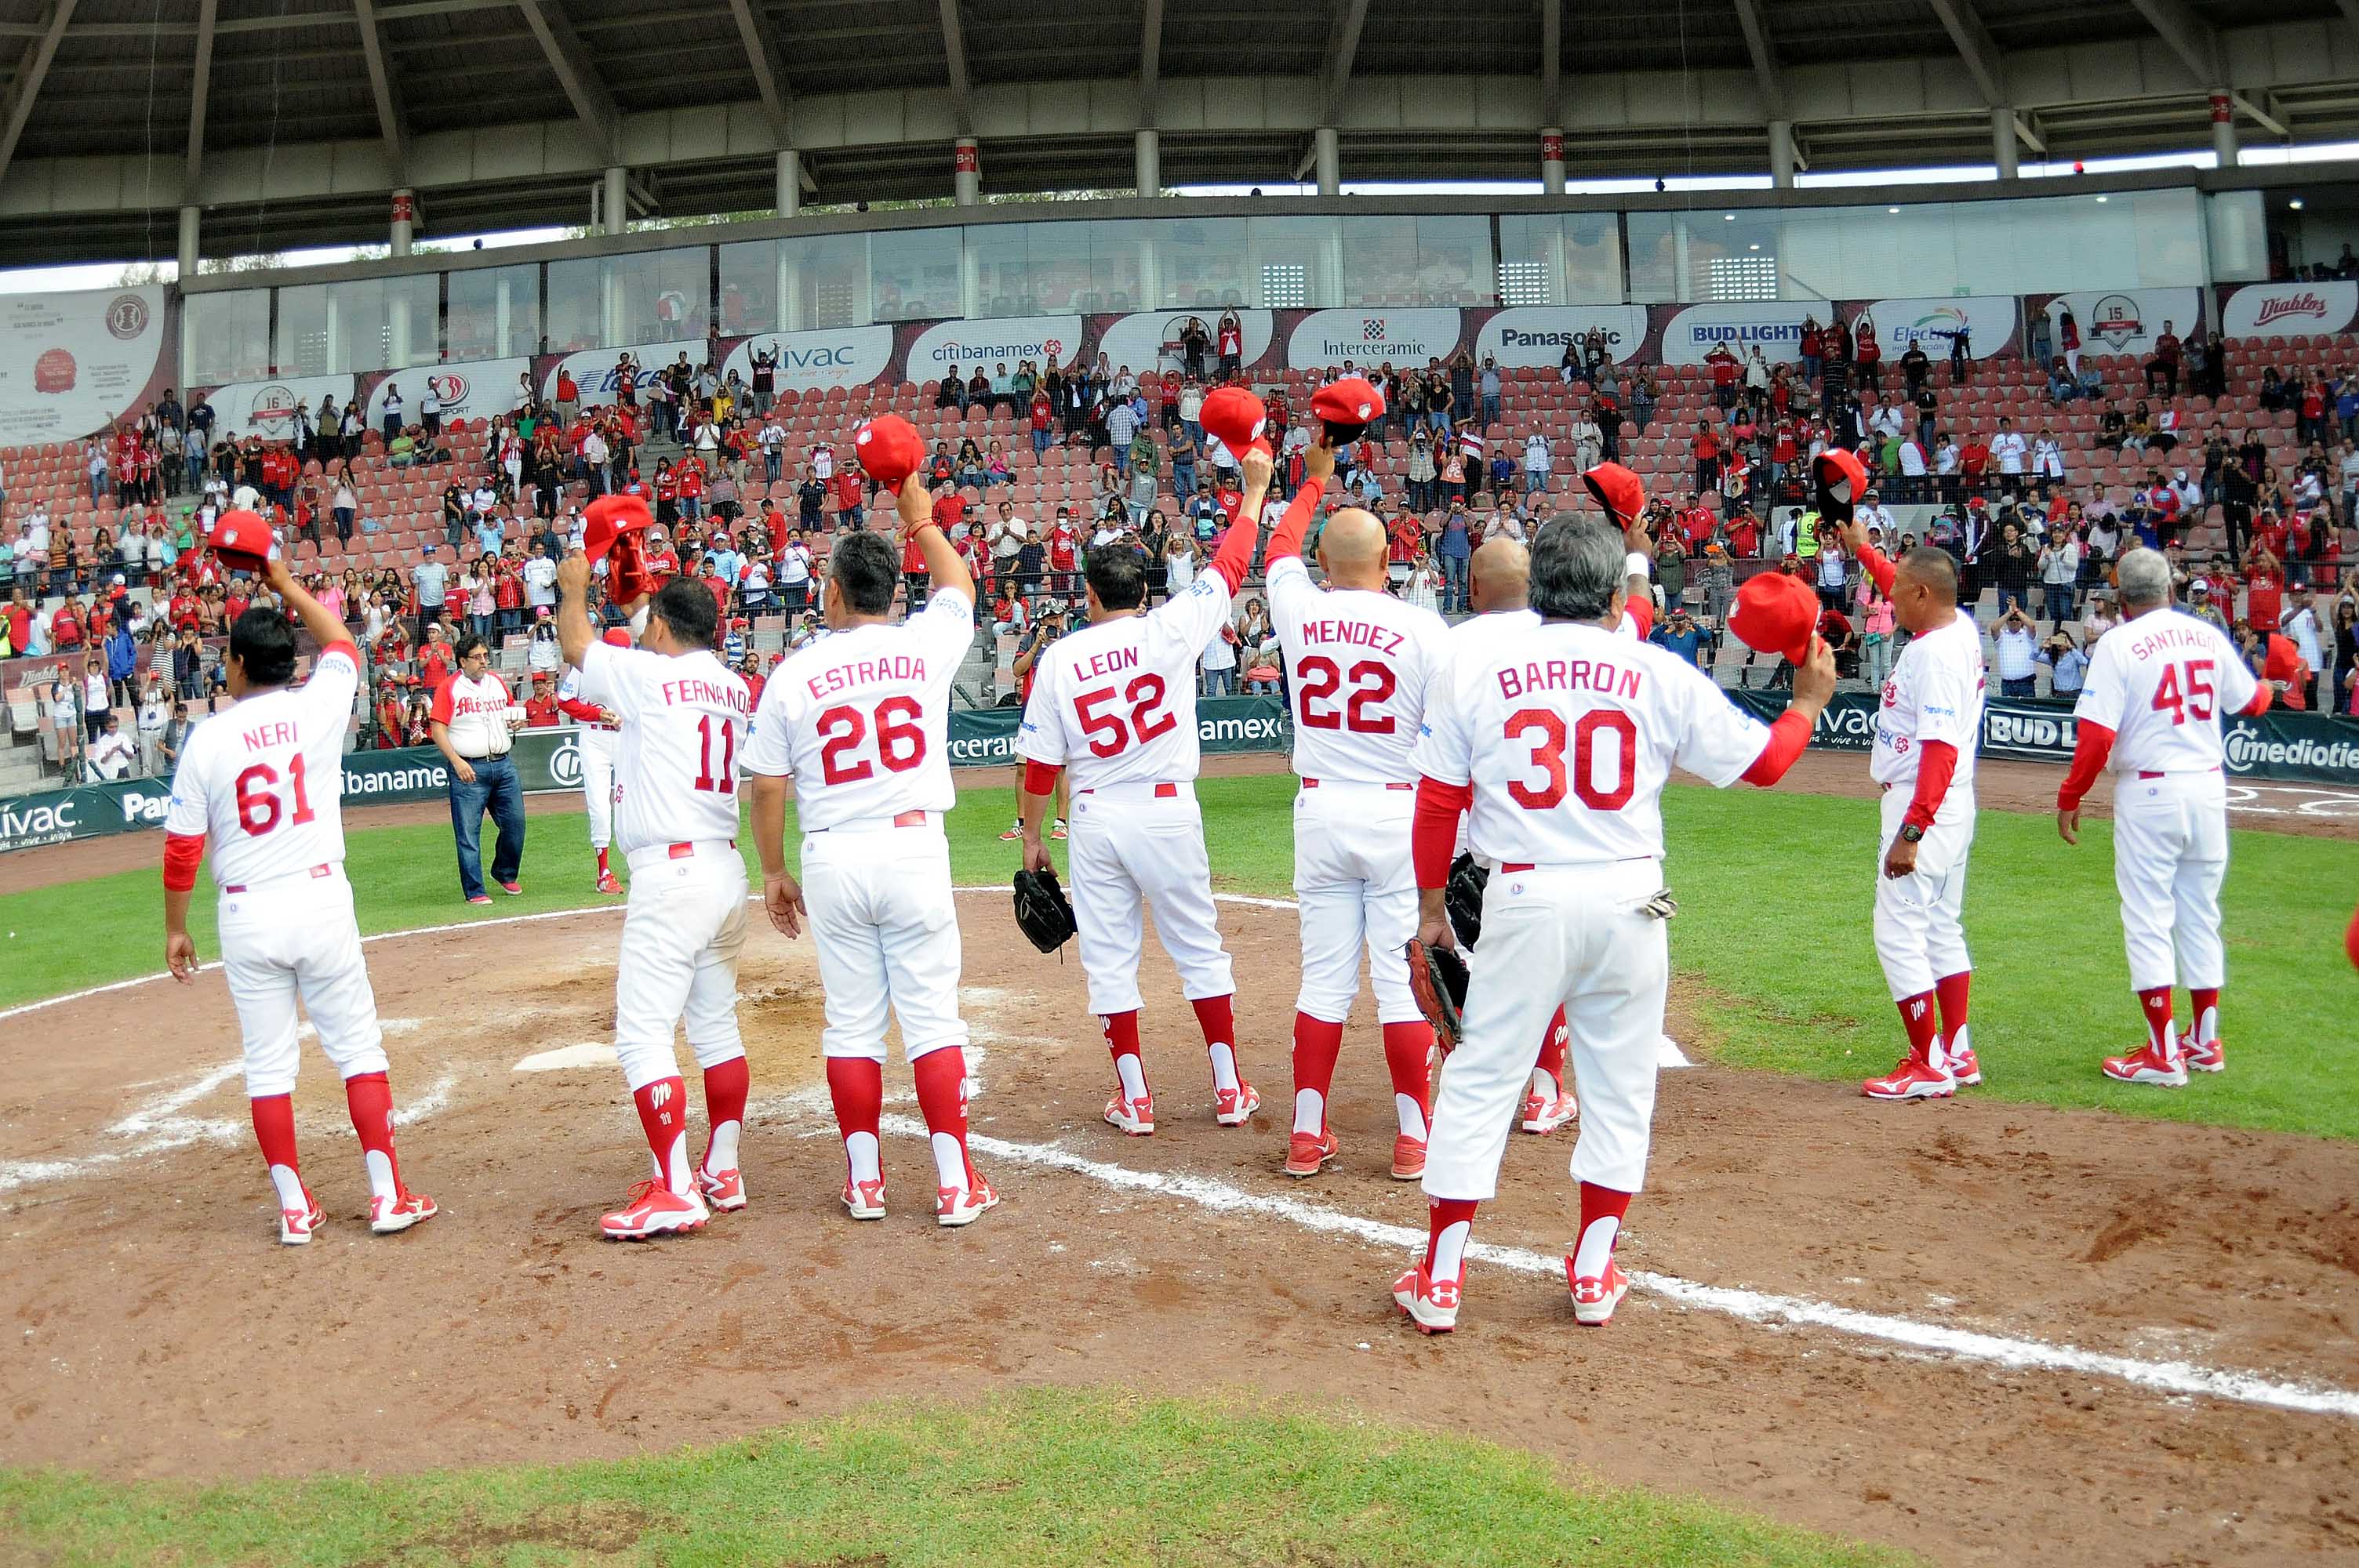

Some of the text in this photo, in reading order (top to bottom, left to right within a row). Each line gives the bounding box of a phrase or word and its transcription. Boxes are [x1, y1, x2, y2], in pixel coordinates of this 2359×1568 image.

[2108, 307, 2122, 320] 15
[2255, 292, 2328, 323] Diablos
[1324, 339, 1426, 356] Interceramic
[1502, 328, 1621, 347] Panasoic
[1693, 325, 1801, 342] BUD LIGHT
[932, 342, 1043, 361] citibanamex
[267, 397, 279, 408] 16
[1303, 620, 1405, 657] MENDEZ
[2132, 629, 2216, 660] SANTIAGO
[808, 656, 926, 700] ESTRADA
[1073, 647, 1138, 682] LEON
[1497, 660, 1641, 699] BARRON
[1297, 655, 1396, 734] 22
[2151, 659, 2214, 726] 45
[1073, 673, 1178, 759] 52
[1199, 717, 1276, 740] amex
[1990, 715, 2078, 747] BUD L
[242, 720, 298, 753] NERI
[816, 695, 927, 785] 26
[1831, 736, 1852, 745] vive
[694, 714, 735, 794] 11
[1503, 709, 1637, 811] 30
[2243, 739, 2359, 769] mediotie
[235, 753, 315, 837] 61
[340, 767, 449, 795] ibaname
[660, 1112, 672, 1125] 11
